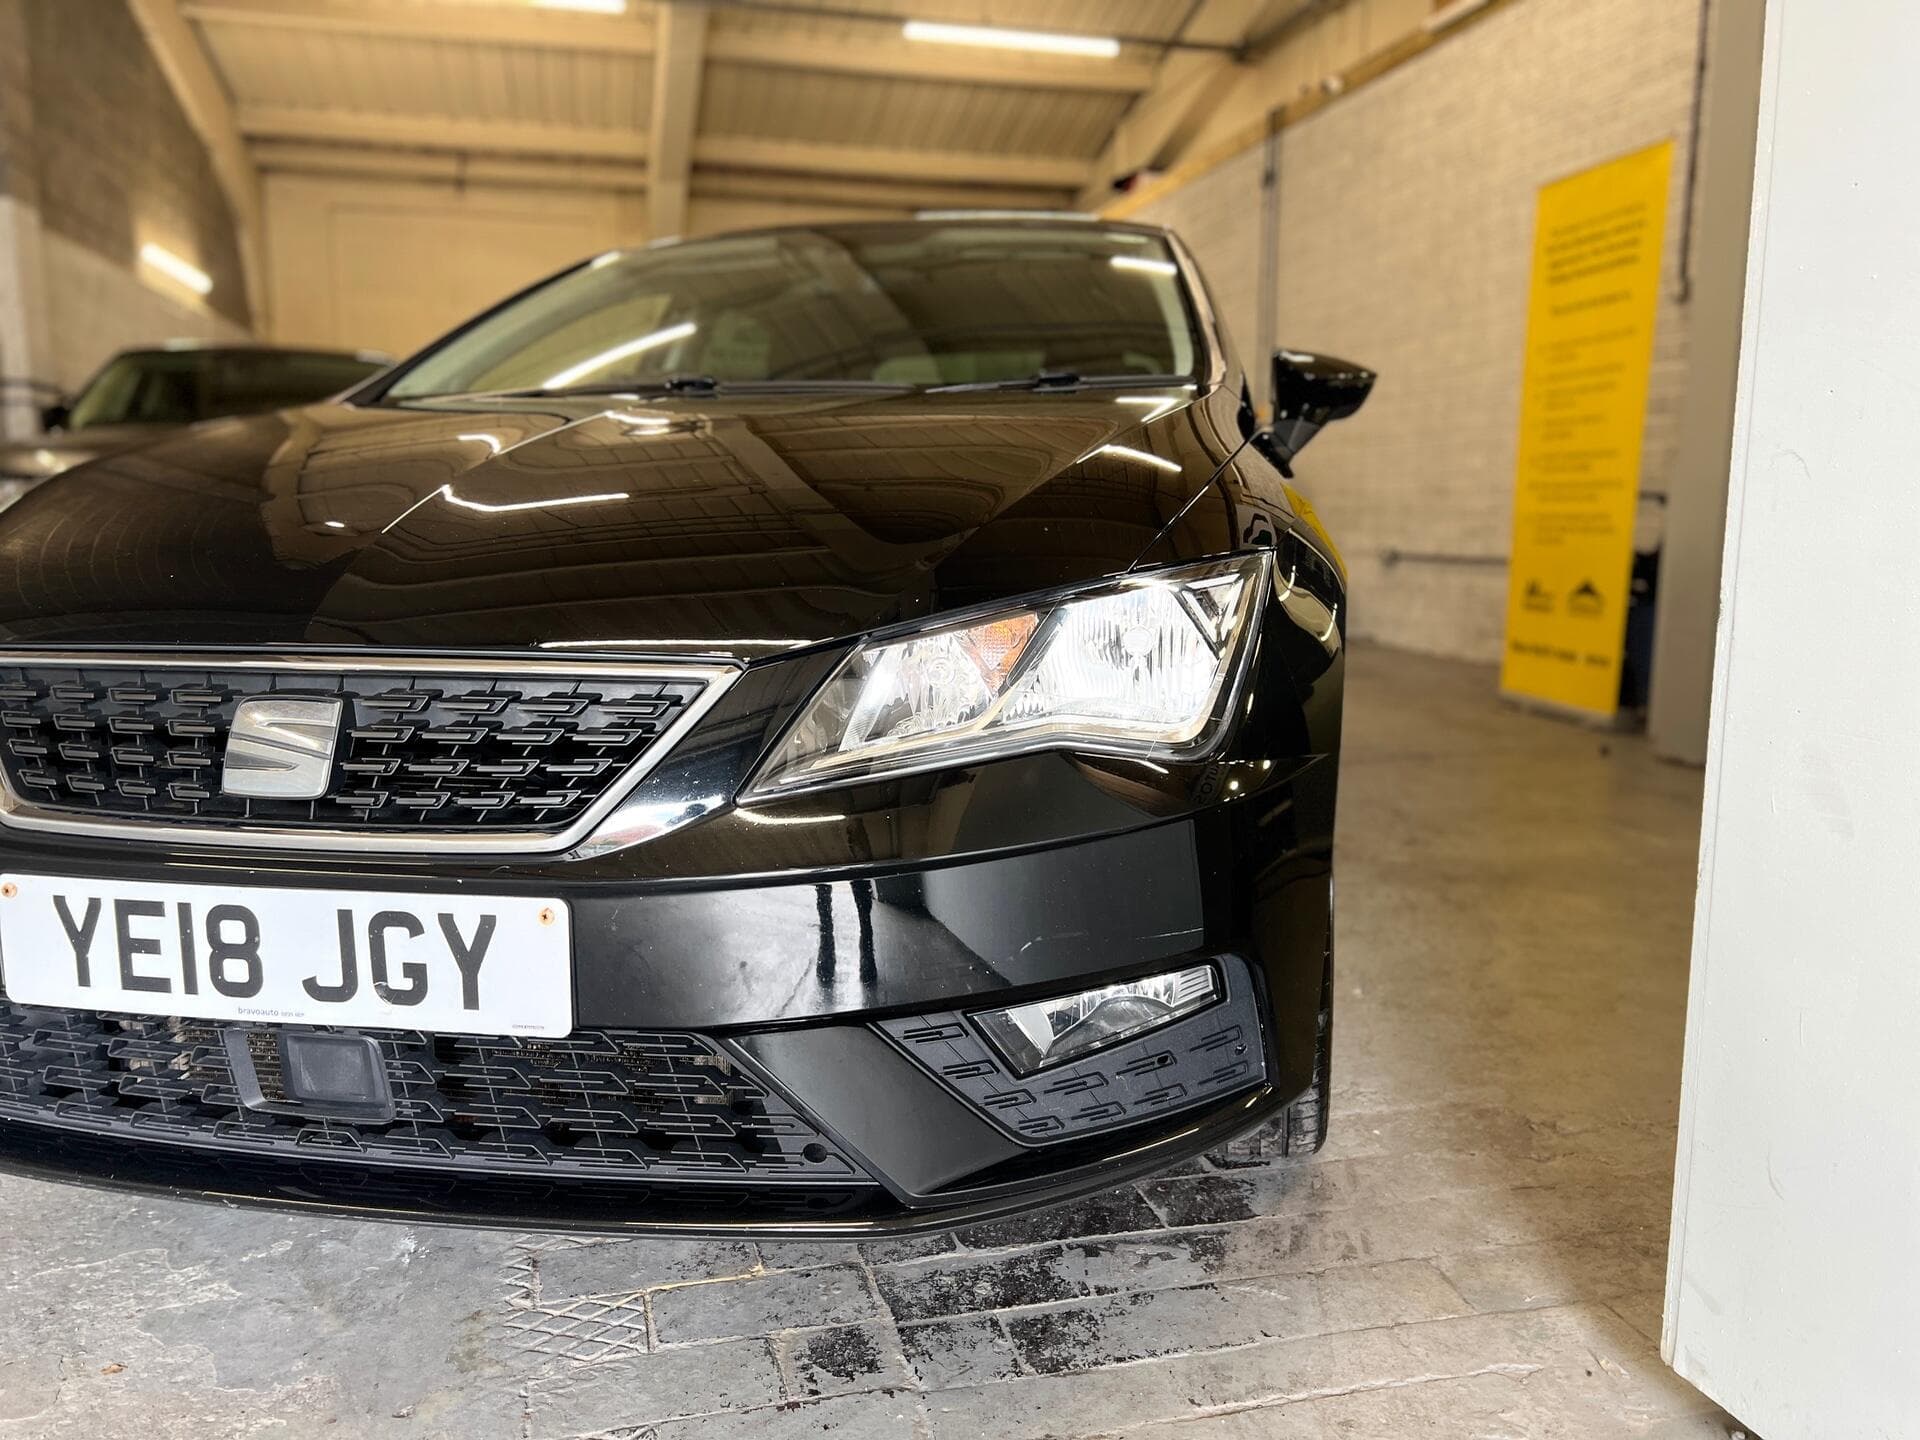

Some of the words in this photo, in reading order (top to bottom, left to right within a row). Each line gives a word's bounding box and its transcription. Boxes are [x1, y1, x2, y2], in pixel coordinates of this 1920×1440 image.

[52, 894, 264, 998] YE18
[301, 908, 497, 1011] JGY
[237, 1006, 279, 1017] bravoauto
